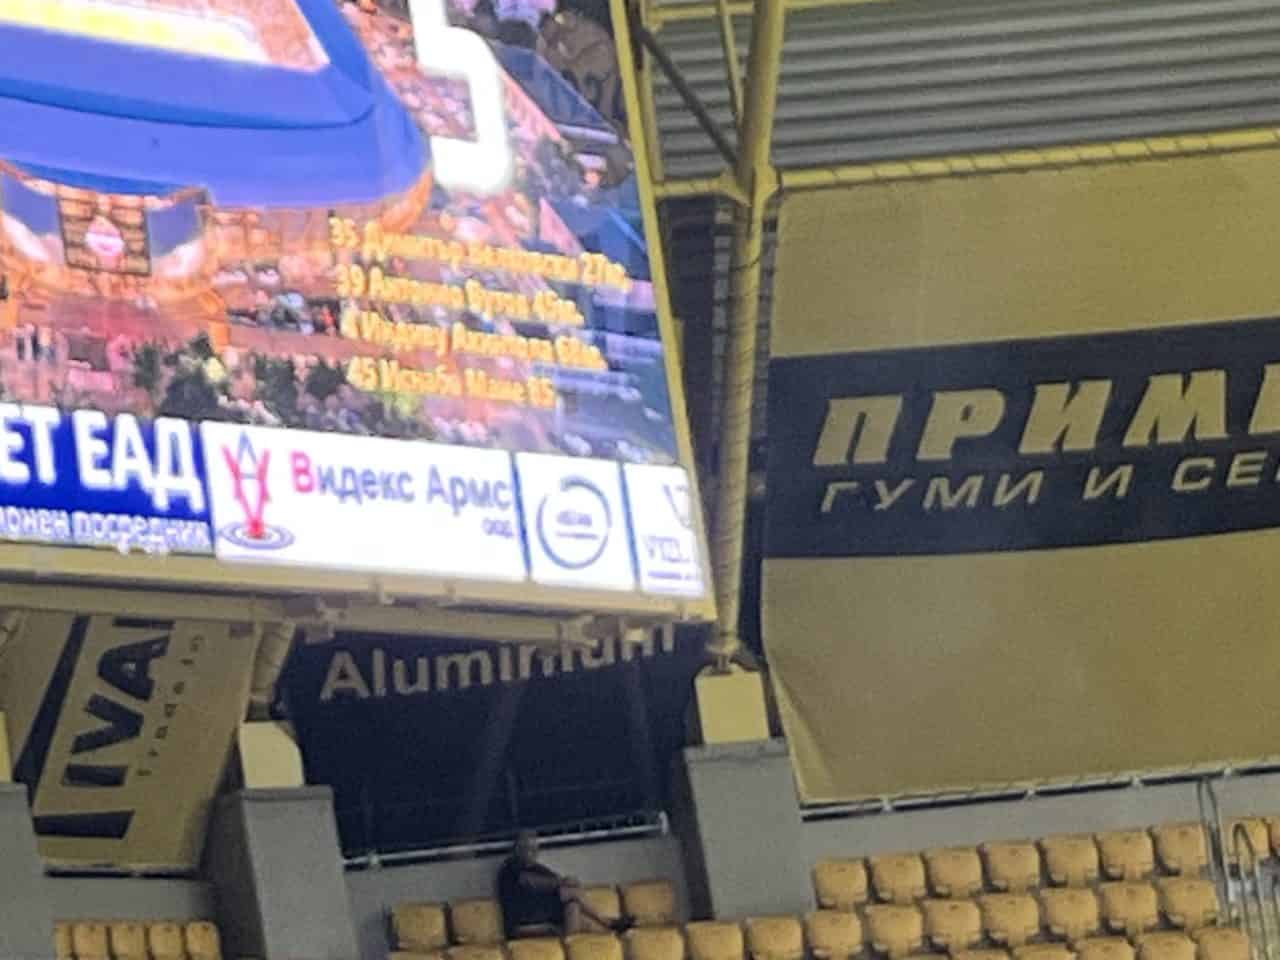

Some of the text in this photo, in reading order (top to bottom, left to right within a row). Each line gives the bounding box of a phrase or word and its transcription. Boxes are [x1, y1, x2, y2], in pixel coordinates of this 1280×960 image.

[73, 408, 205, 512] ЕАД
[290, 452, 511, 515] Видекс Армс
[821, 450, 1280, 513] ГУМИ И СЕ
